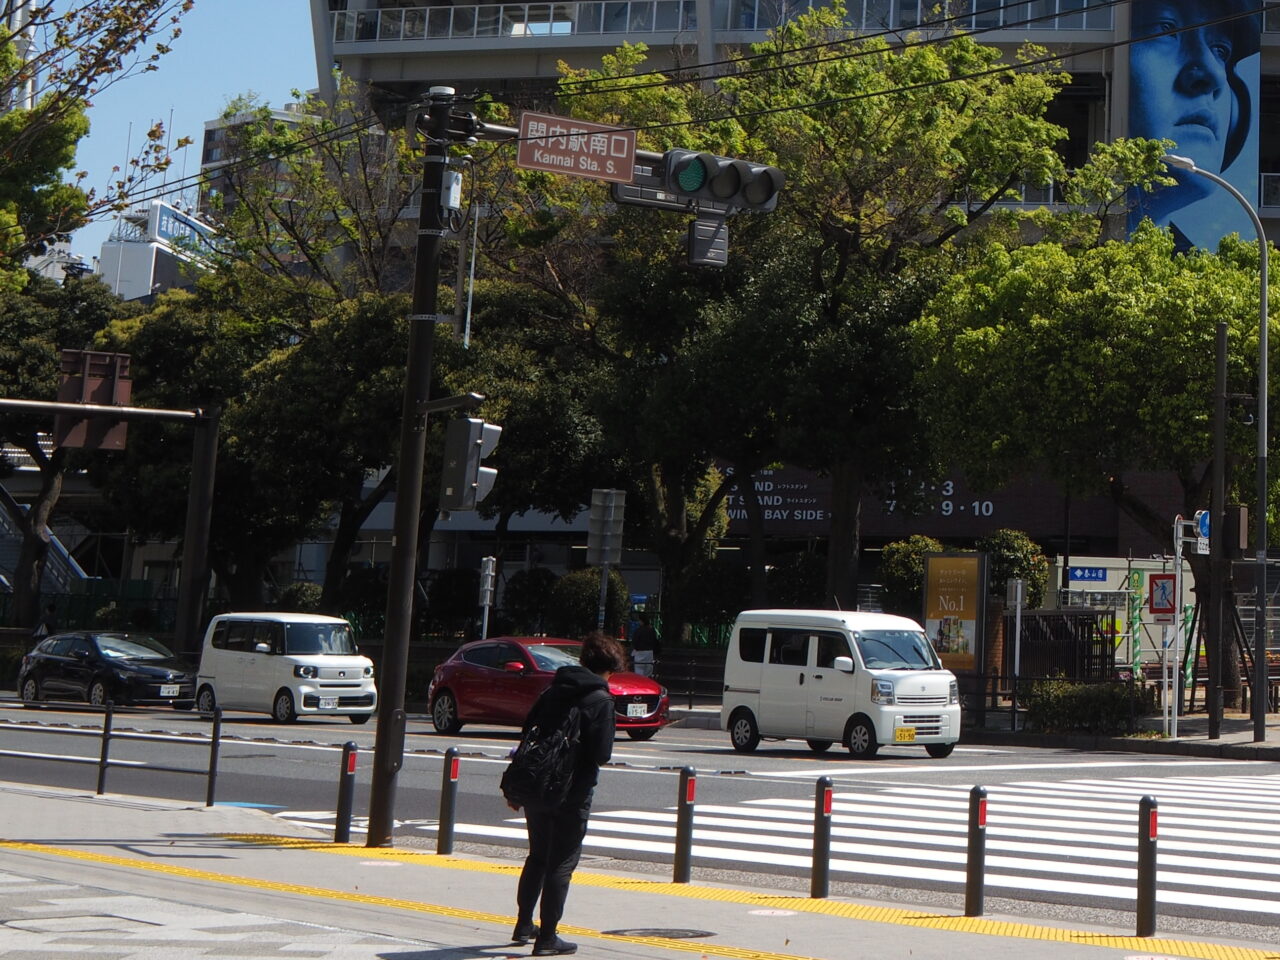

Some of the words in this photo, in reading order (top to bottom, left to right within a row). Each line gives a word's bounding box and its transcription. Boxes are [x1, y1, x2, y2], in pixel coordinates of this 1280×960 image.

[526, 121, 628, 158] 関内駅南口
[534, 149, 574, 168] Kannai
[579, 157, 600, 171] Sta.
[606, 162, 617, 174] S.
[764, 509, 789, 520] BAY
[793, 510, 824, 520] SIDE
[938, 595, 964, 612] No.1
